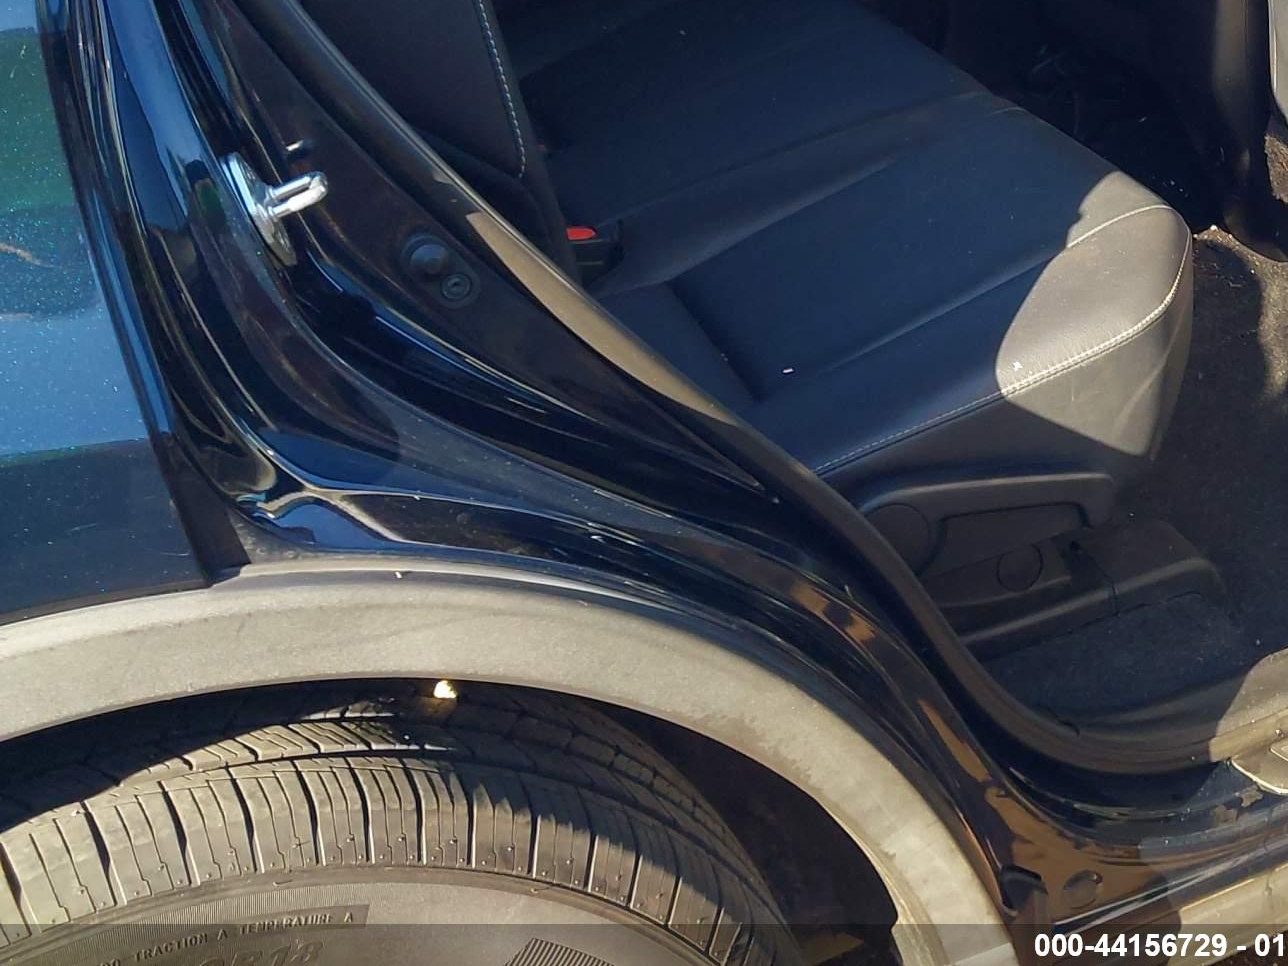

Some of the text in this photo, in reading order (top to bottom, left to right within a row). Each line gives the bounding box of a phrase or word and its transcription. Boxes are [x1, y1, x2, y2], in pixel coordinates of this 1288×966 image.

[134, 933, 208, 962] TRACTION
[217, 929, 228, 940] A
[240, 913, 331, 935] TEMPERATURE
[344, 911, 353, 923] A
